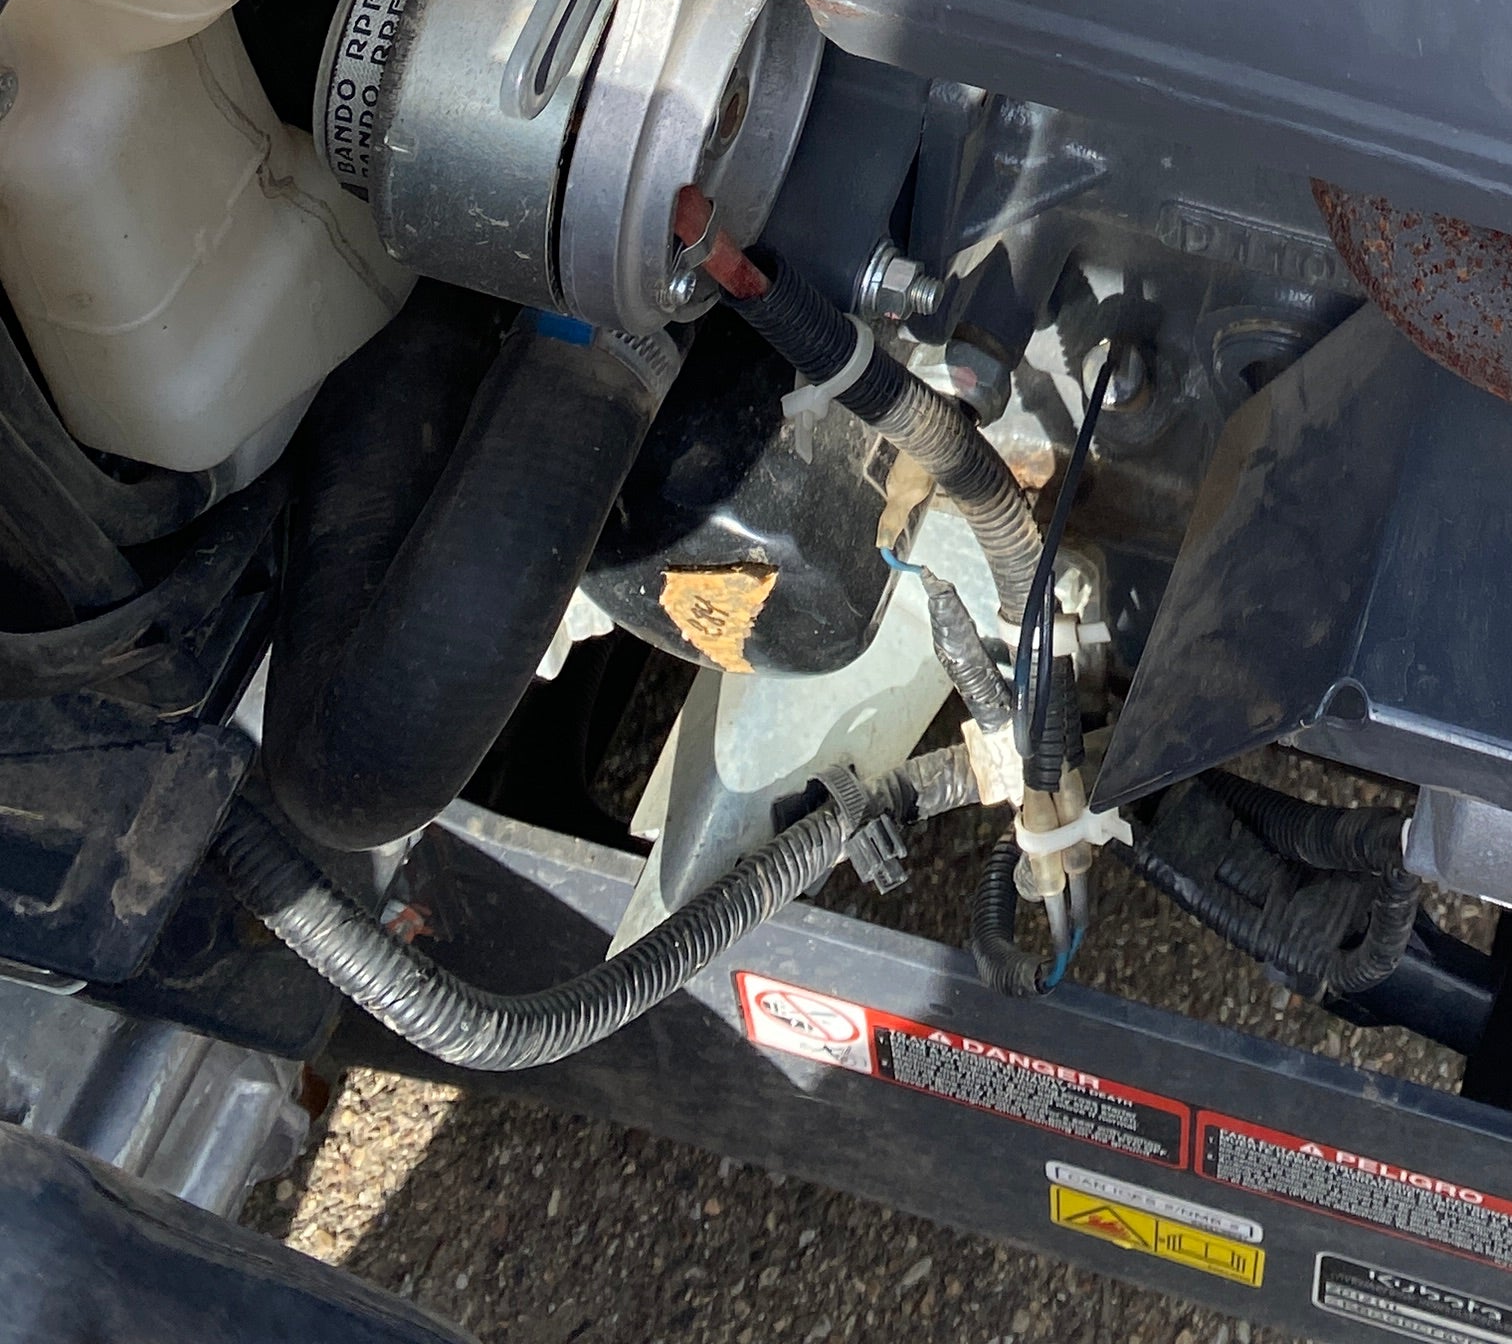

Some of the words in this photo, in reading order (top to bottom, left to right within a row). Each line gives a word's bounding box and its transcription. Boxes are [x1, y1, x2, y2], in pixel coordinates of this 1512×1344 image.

[334, 78, 357, 176] BANDO
[961, 1037, 1103, 1092] DANGER
[1335, 1149, 1484, 1205] PELIGRO
[1368, 1268, 1503, 1322] Kubota
